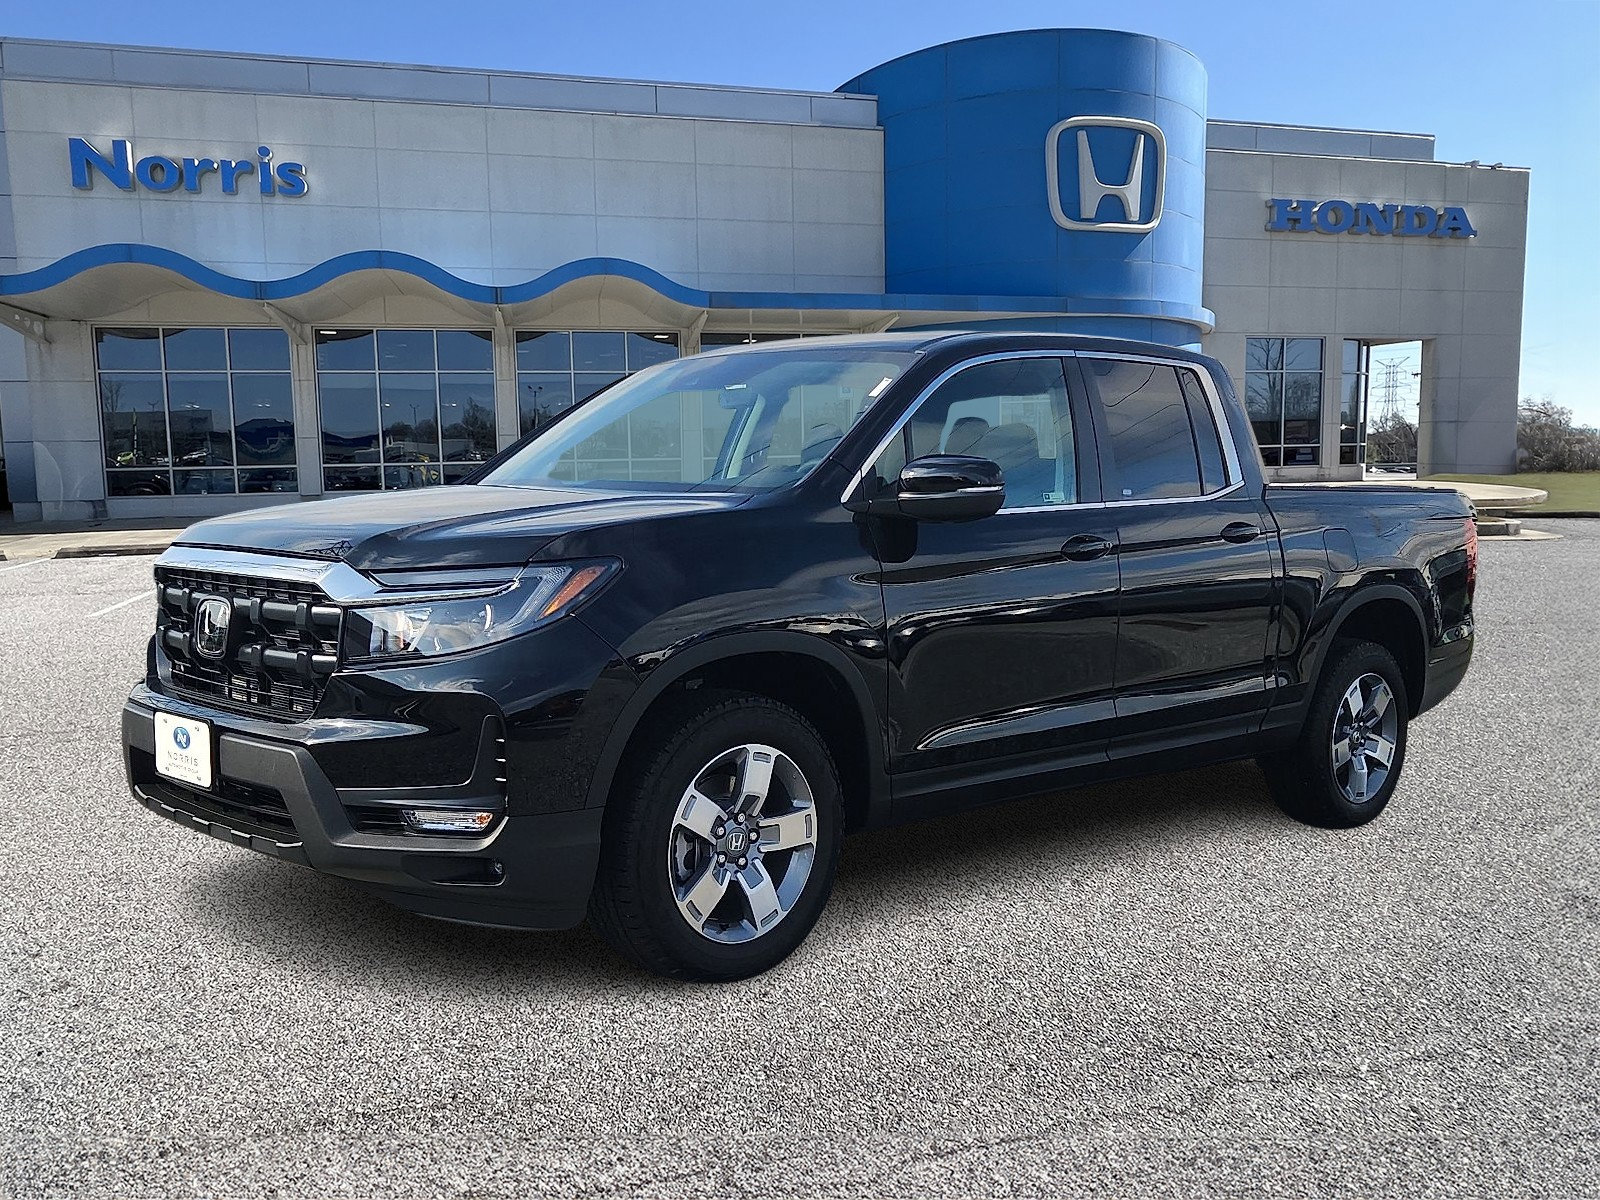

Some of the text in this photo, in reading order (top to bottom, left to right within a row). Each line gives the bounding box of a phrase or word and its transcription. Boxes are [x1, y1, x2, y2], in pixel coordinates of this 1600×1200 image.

[68, 137, 309, 197] Norris
[1265, 198, 1478, 240] HONDA
[167, 750, 198, 767] NORRIS
